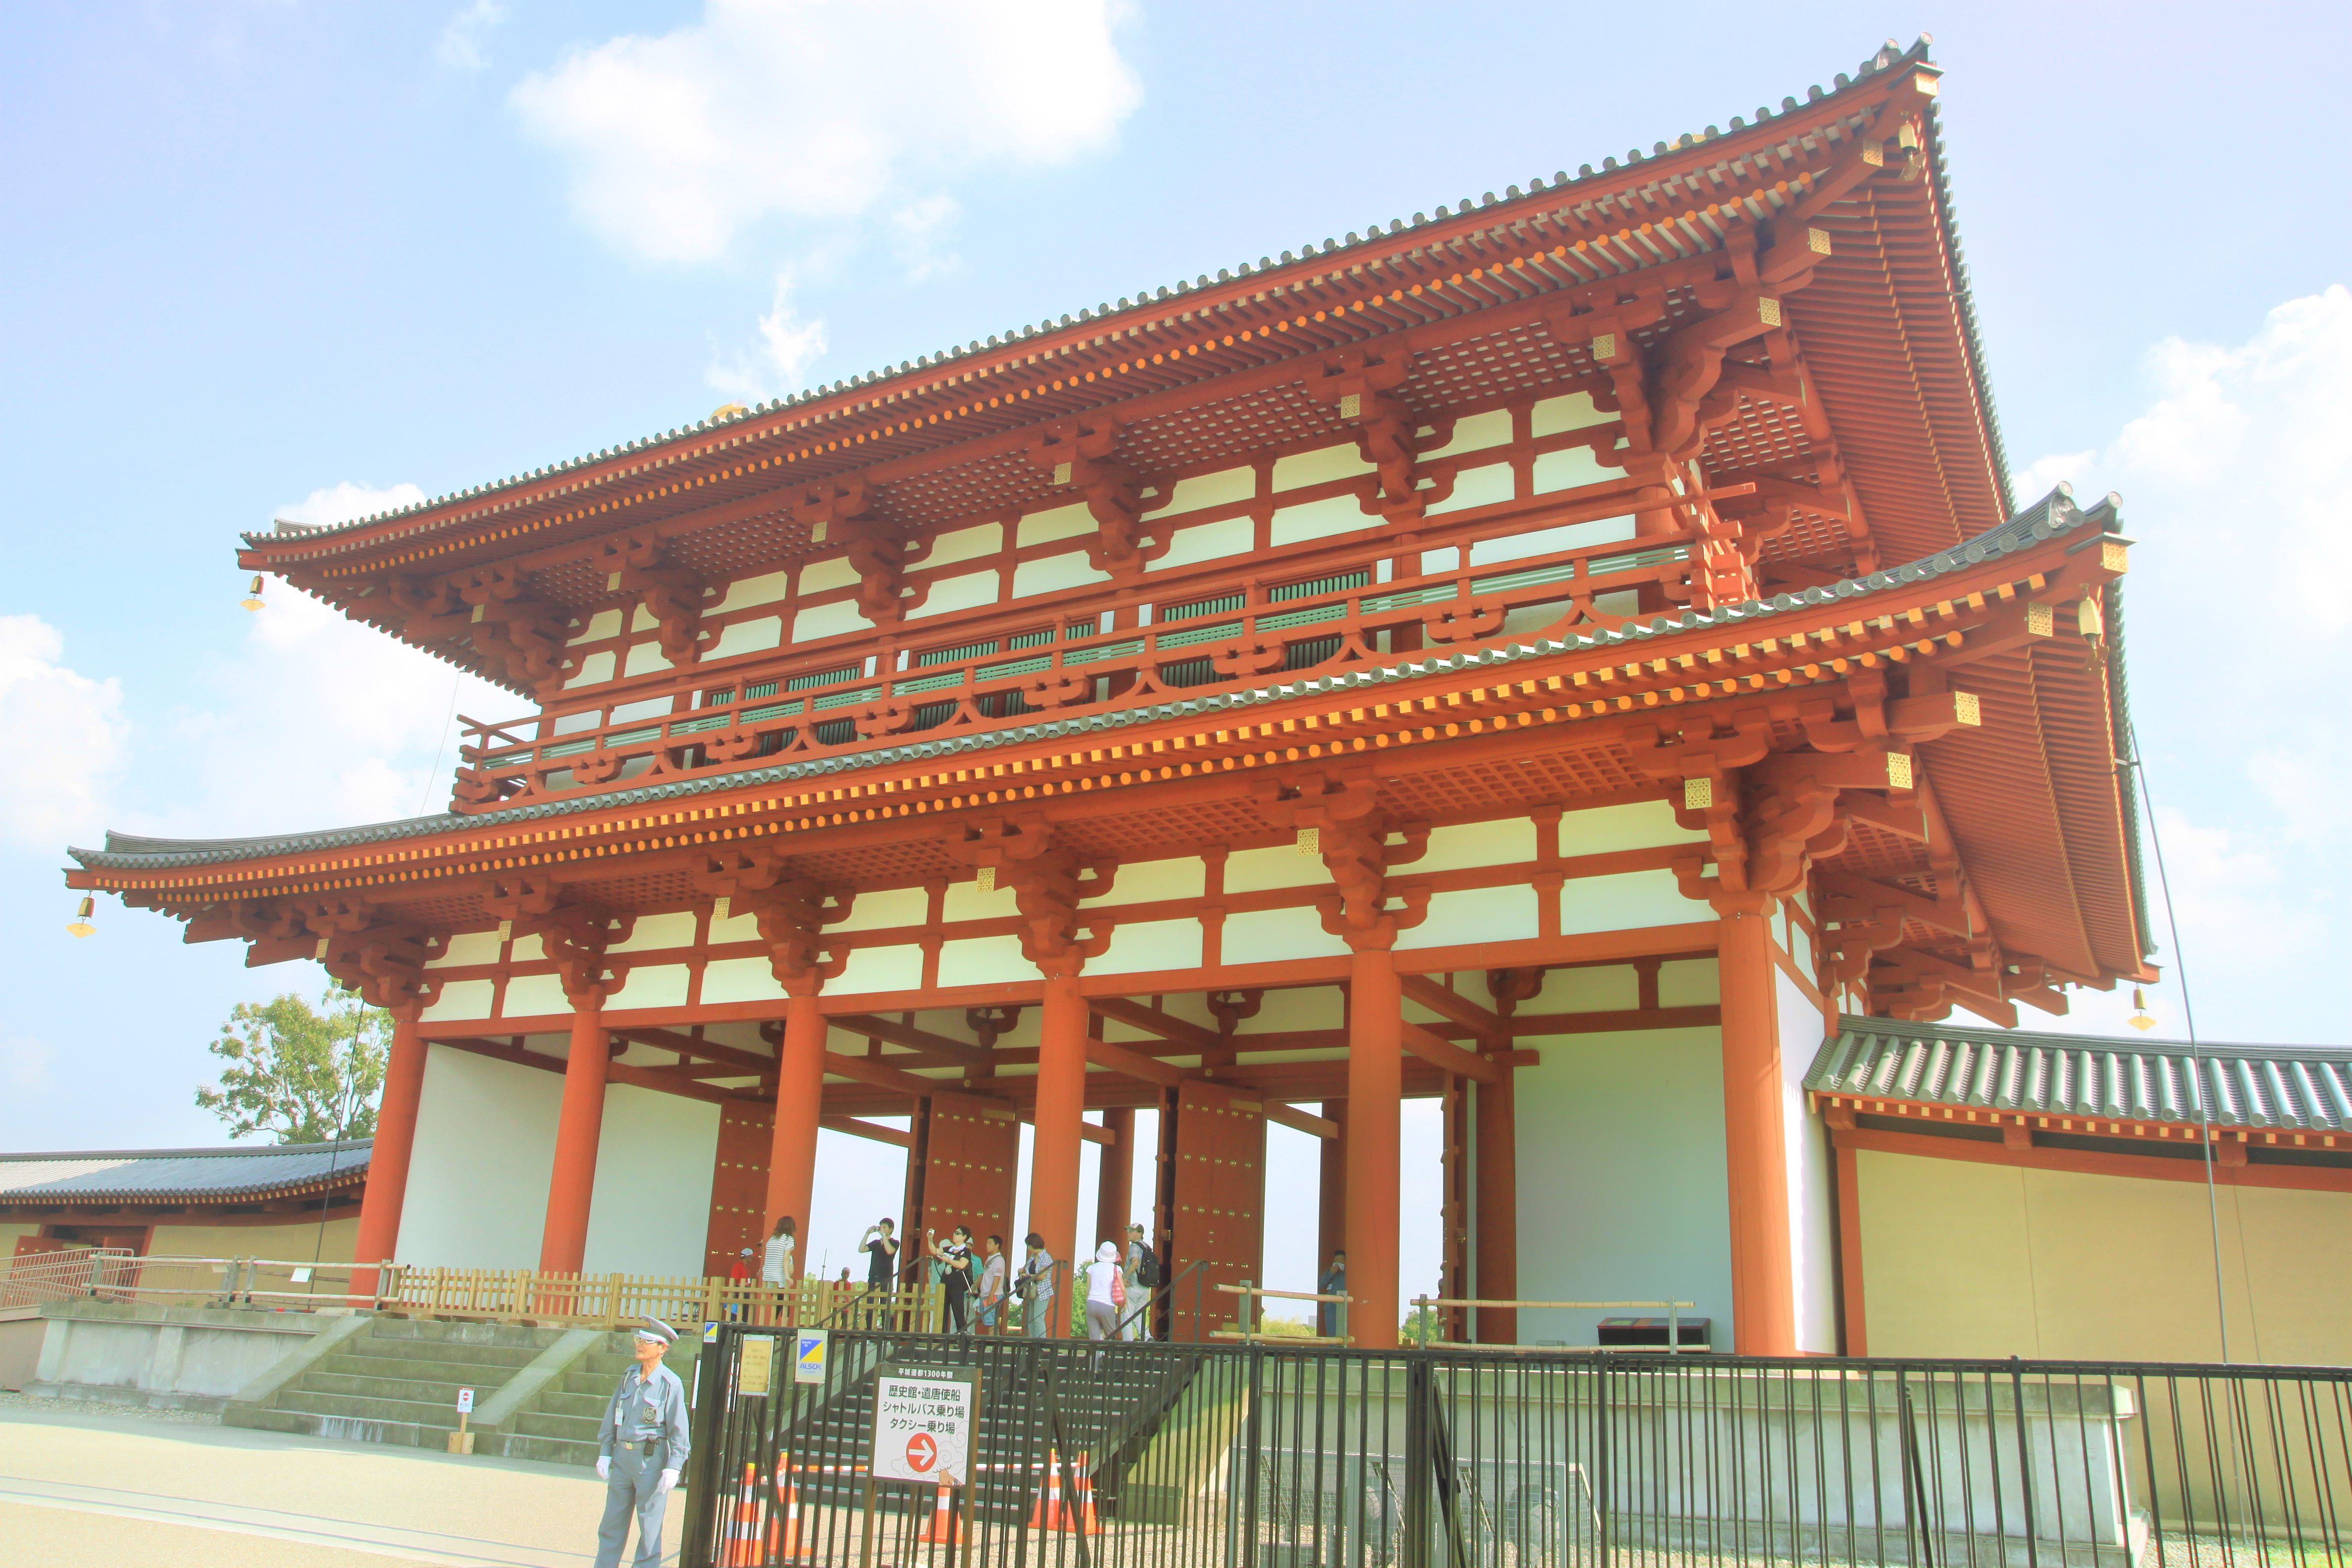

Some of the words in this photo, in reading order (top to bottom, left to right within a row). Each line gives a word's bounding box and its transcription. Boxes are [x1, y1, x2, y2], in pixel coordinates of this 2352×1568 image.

[883, 1401, 965, 1419] シャトルバス乗り場
[890, 1417, 955, 1434] タクシー乗り場
